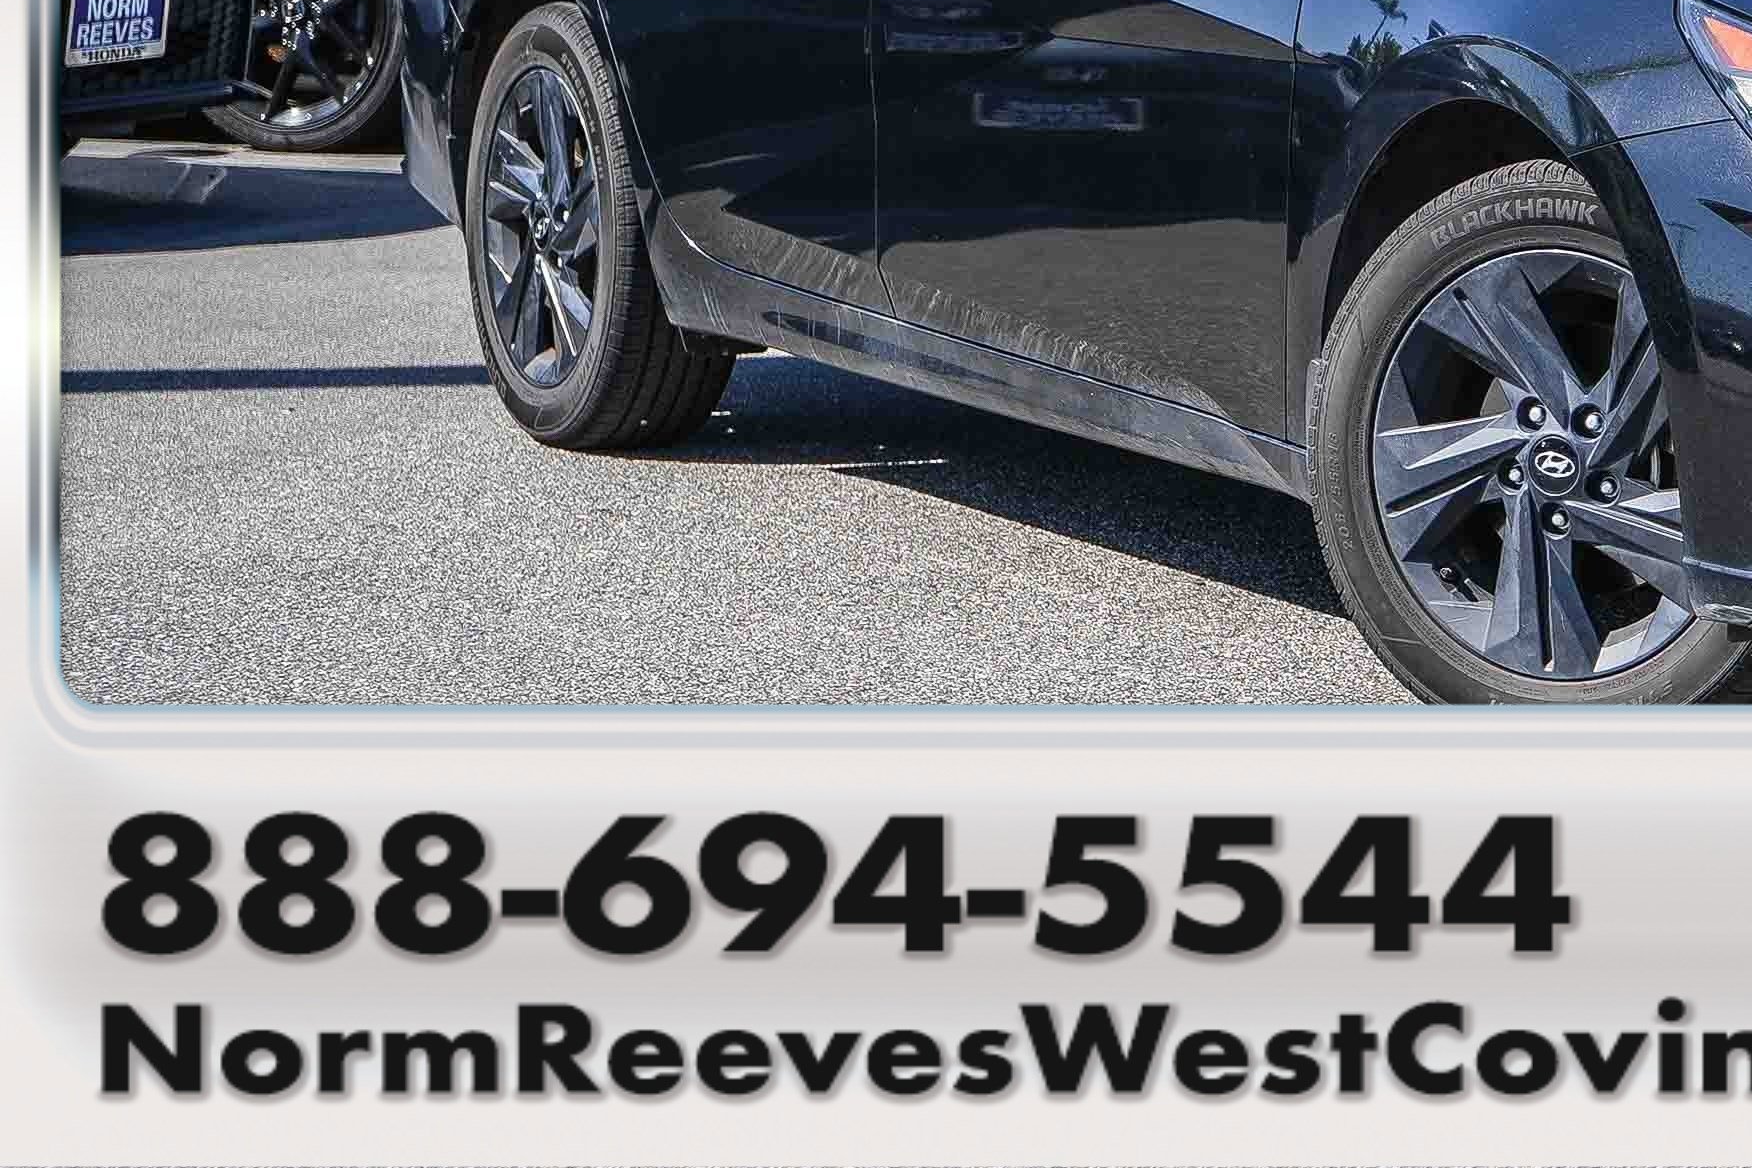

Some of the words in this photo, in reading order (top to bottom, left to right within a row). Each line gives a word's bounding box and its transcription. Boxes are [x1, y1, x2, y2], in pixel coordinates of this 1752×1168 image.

[76, 17, 154, 48] REEVES
[87, 47, 144, 63] HONDA
[1430, 197, 1599, 249] BLACKHAWK
